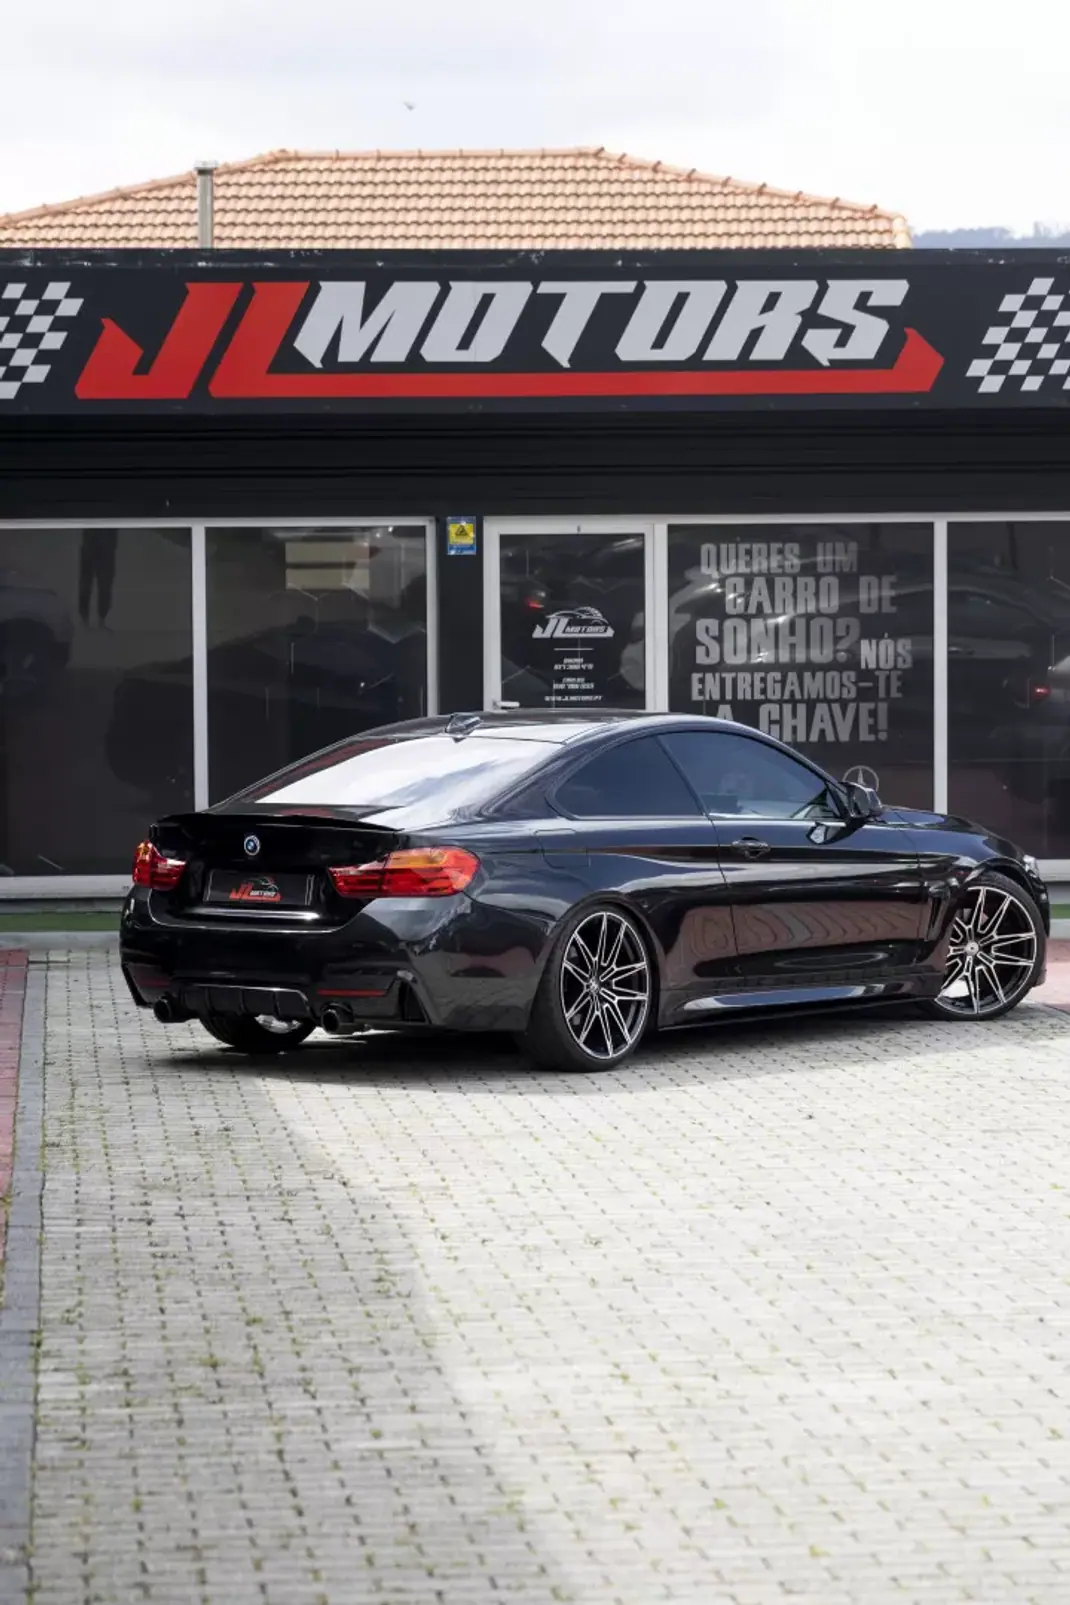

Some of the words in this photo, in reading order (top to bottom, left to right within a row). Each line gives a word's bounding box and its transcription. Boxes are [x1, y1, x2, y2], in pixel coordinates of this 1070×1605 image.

[293, 279, 910, 369] MOTORS
[701, 543, 800, 579] QUERES
[816, 542, 858, 573] UM
[725, 576, 840, 615] CARRO
[859, 575, 897, 614] DE
[695, 617, 861, 665] SONHO?
[860, 632, 913, 669] NÓS
[691, 670, 903, 701] ENTREGAMOS-TE
[759, 702, 888, 742] CHAVE!
